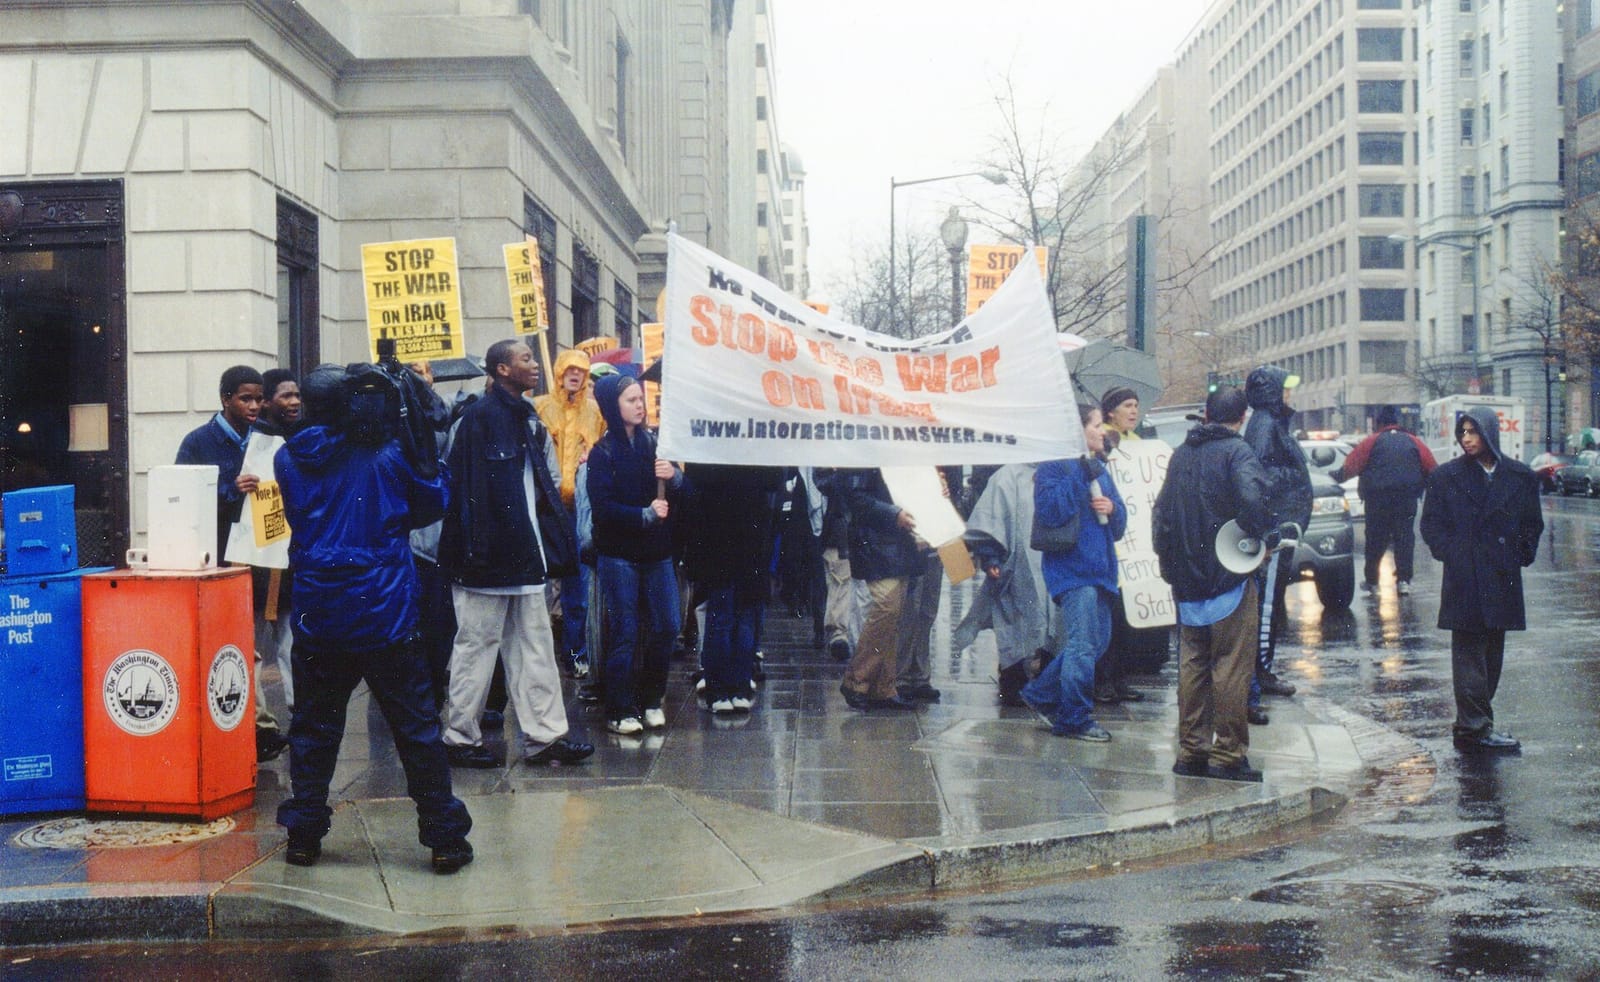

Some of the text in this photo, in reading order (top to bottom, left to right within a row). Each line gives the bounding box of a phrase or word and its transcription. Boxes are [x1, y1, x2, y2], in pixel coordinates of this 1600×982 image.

[385, 248, 434, 272] STOP
[987, 251, 1020, 271] STO
[373, 271, 452, 298] THE WAR
[975, 274, 997, 290] THE
[521, 293, 536, 305] ON
[382, 302, 446, 325] ON IRAQ
[689, 294, 798, 363] Stop
[805, 337, 885, 388] the
[895, 344, 1001, 394] War
[1107, 457, 1133, 485] The
[255, 486, 271, 501] Vote
[9, 594, 31, 610] The
[1134, 591, 1175, 621] Stat
[0, 610, 53, 629] ashington
[8, 629, 33, 645] Post
[106, 653, 175, 695] The Washington Times
